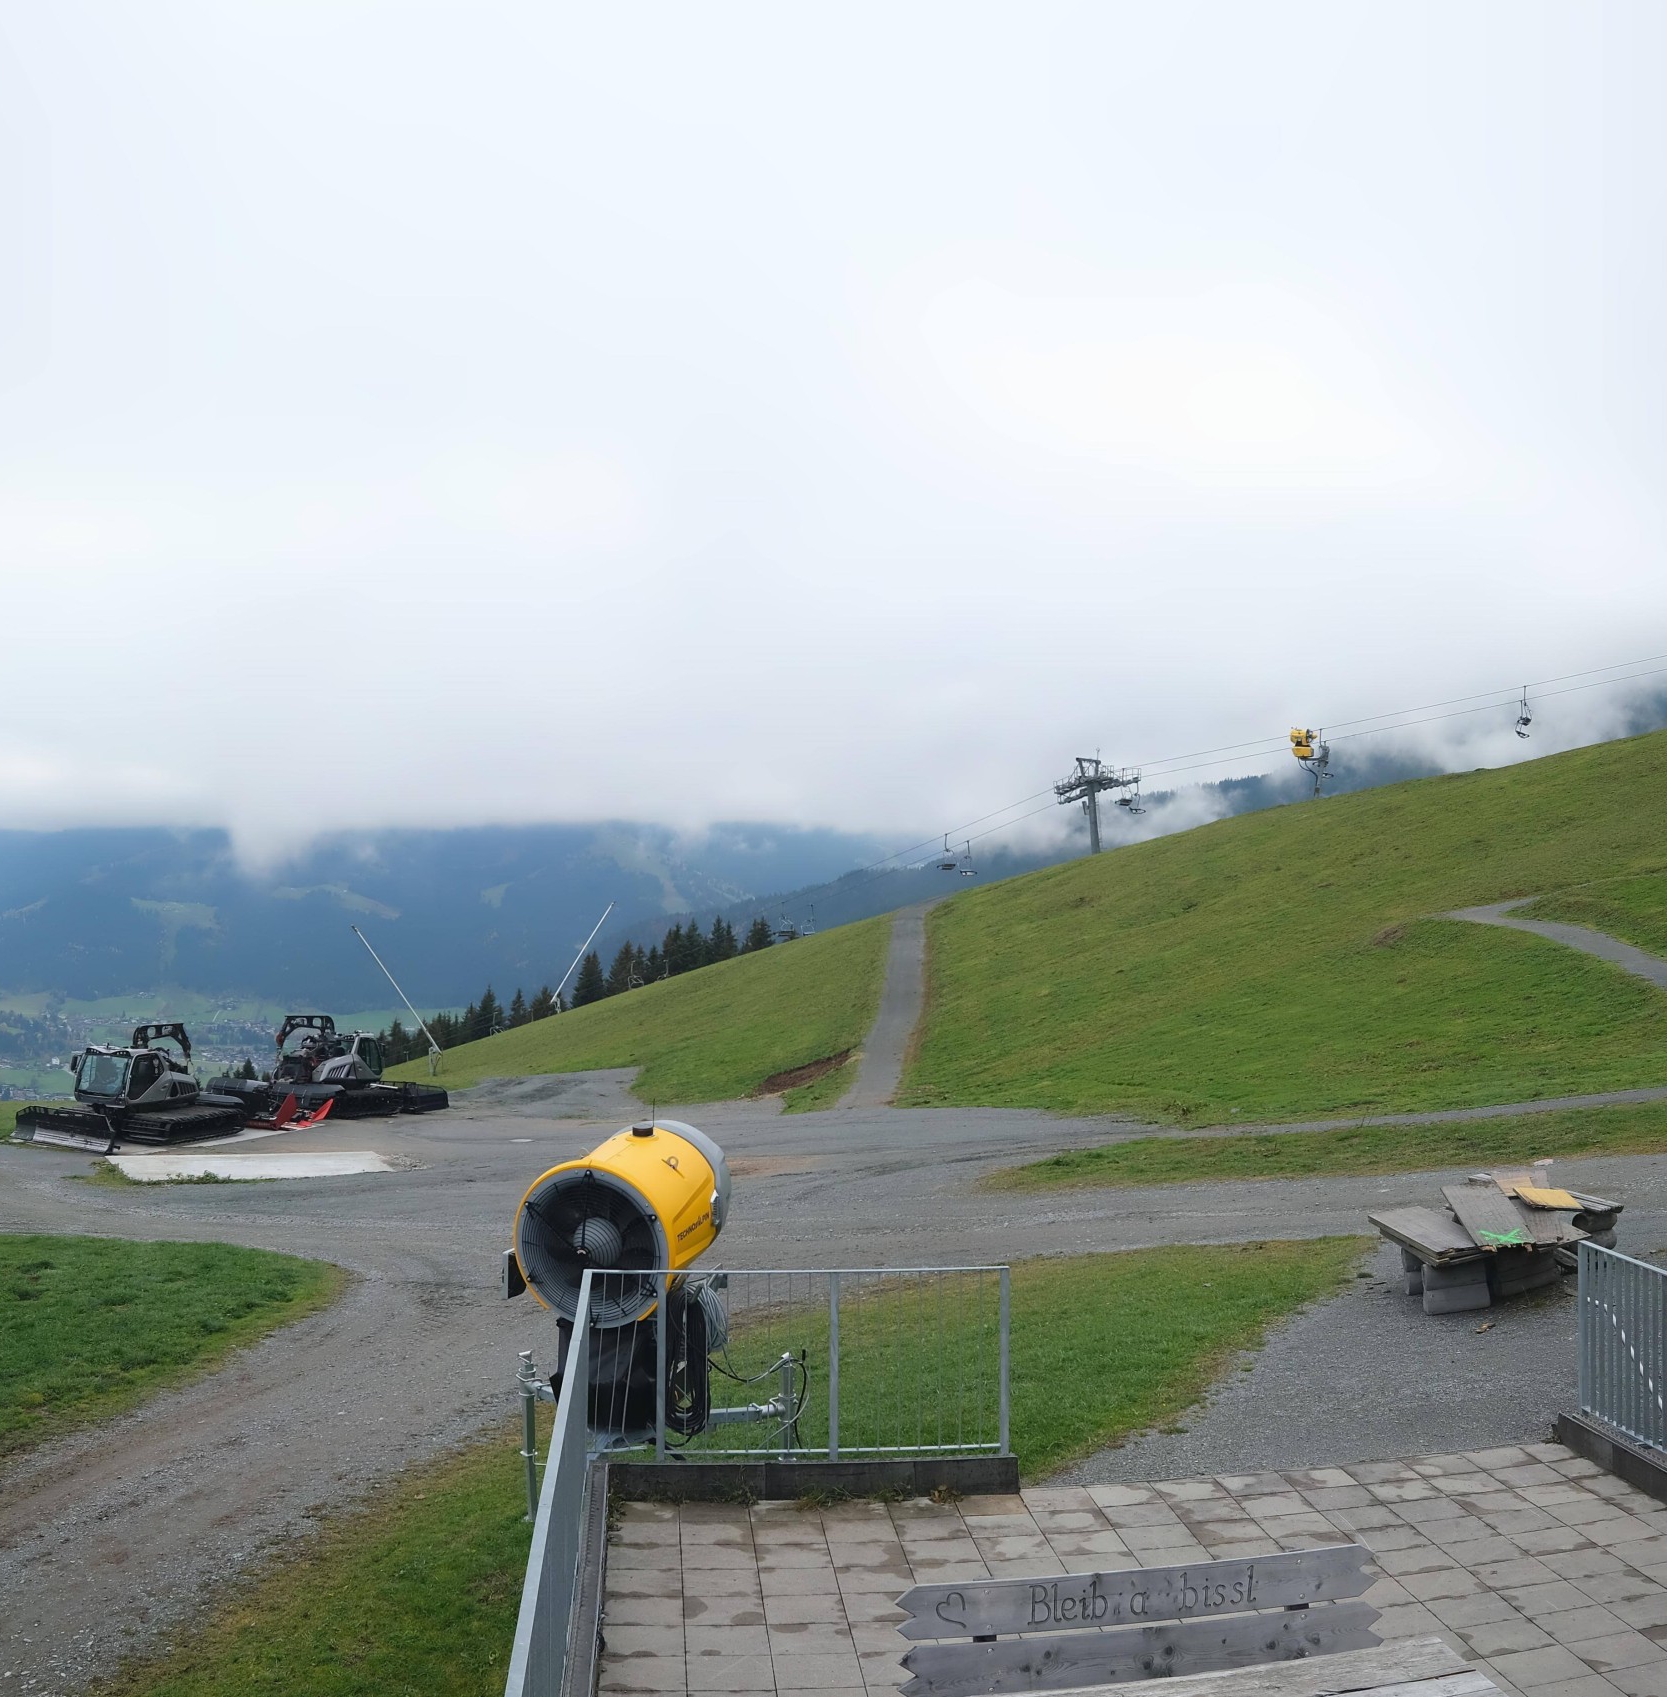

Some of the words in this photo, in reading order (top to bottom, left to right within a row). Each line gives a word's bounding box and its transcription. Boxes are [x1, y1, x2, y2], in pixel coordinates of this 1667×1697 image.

[1027, 1580, 1109, 1627] Bleib
[1129, 1591, 1148, 1616] a
[1178, 1564, 1257, 1612] bissl
